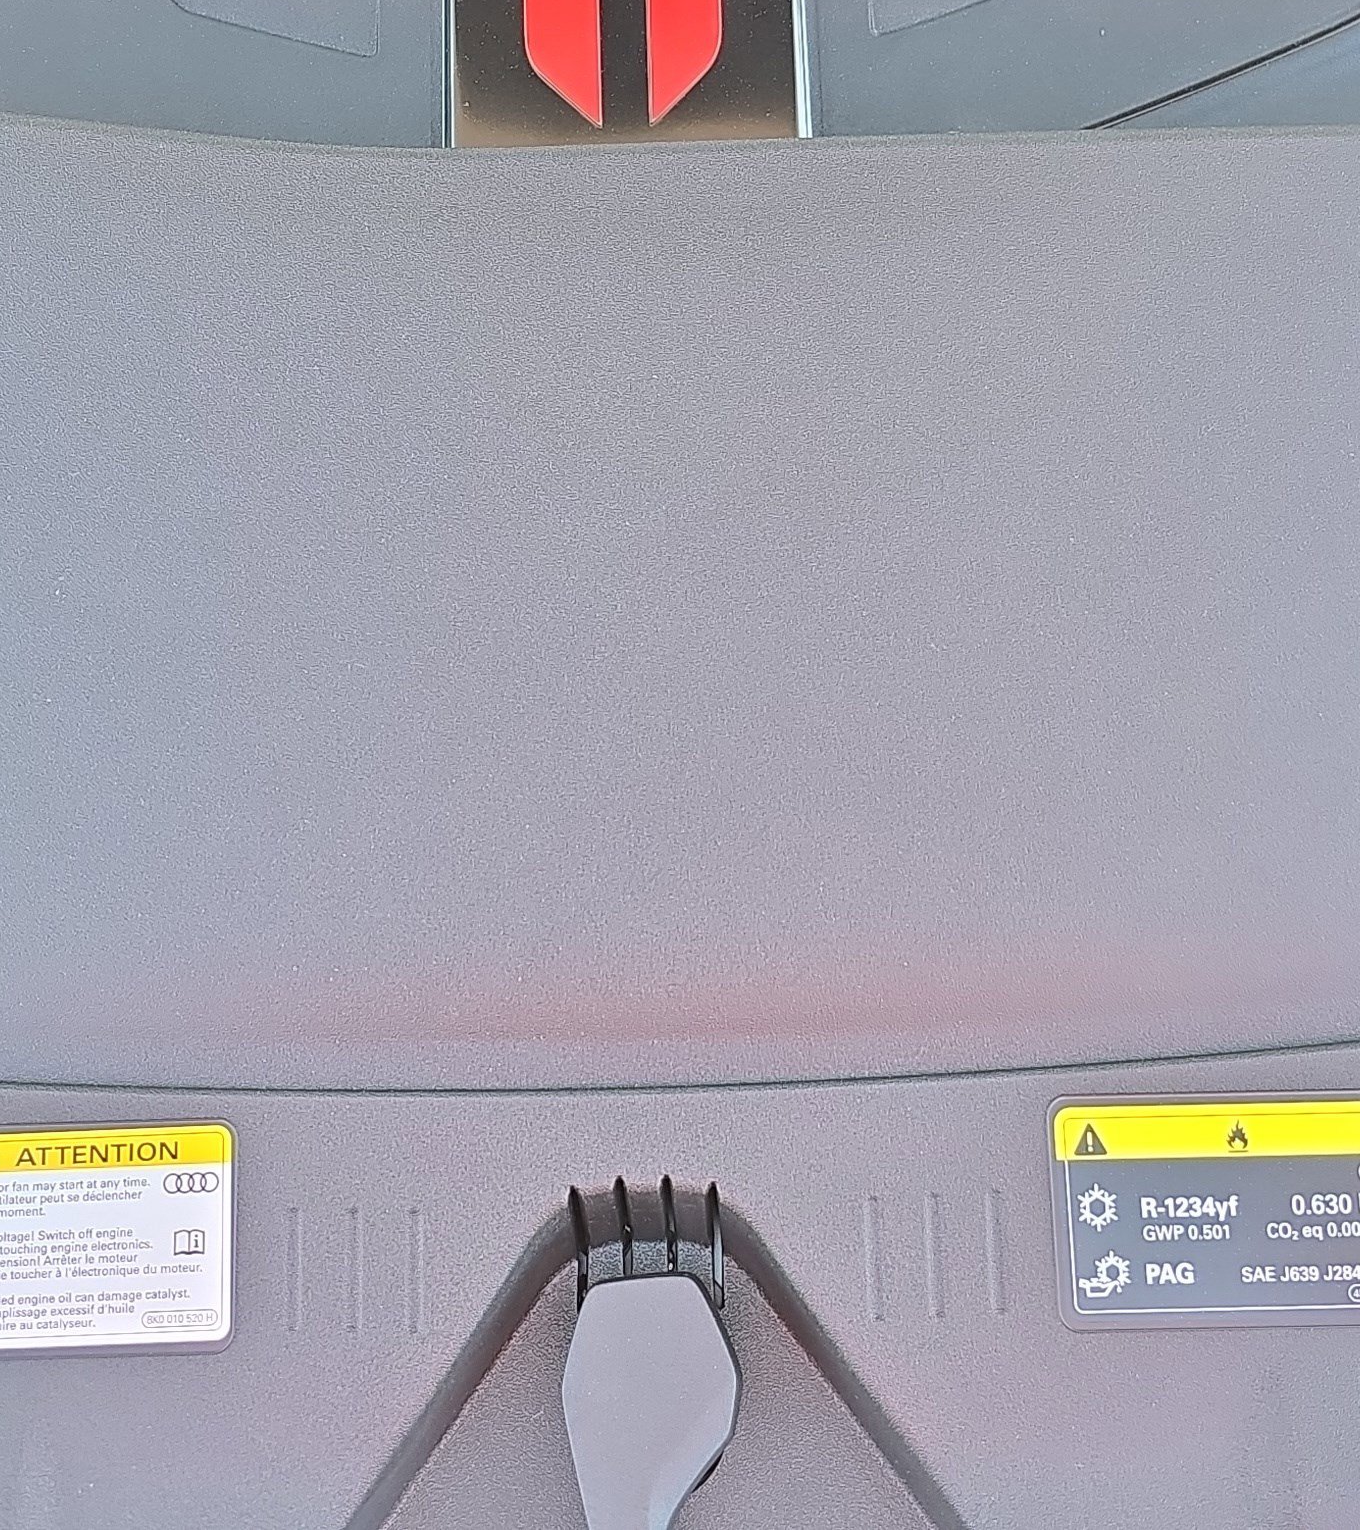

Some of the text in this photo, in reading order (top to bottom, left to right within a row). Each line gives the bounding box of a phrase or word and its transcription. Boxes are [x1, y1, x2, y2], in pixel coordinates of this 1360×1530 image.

[15, 1141, 178, 1167] ATTENTION
[11, 1181, 30, 1192] fan
[32, 1182, 57, 1193] may
[58, 1180, 84, 1191] start
[86, 1179, 98, 1189] at
[99, 1179, 121, 1190] any
[122, 1176, 151, 1188] time.
[39, 1193, 65, 1206] peut
[66, 1193, 80, 1203] se
[82, 1189, 143, 1202] déclencher
[1291, 1193, 1353, 1216] 0.630
[1140, 1195, 1239, 1222] R-1234yf
[37, 1228, 76, 1241] Switch
[78, 1227, 94, 1240] off
[95, 1226, 133, 1241] engine
[1142, 1224, 1231, 1242] GWP 0.501
[1301, 1225, 1324, 1241] eq
[50, 1241, 89, 1255] engine
[90, 1238, 154, 1252] electronics.
[42, 1254, 83, 1266] Arrêter
[85, 1253, 95, 1265] le
[97, 1253, 138, 1264] moteur
[10, 1268, 53, 1280] toucher
[65, 1264, 140, 1278] l'électronique
[142, 1263, 157, 1275] du
[160, 1264, 203, 1274] moteur.
[1145, 1262, 1195, 1285] PAG
[1241, 1266, 1278, 1283] SAE
[1280, 1265, 1320, 1282] J639
[17, 1293, 56, 1307] engine
[58, 1292, 72, 1304] oil
[74, 1293, 95, 1303] can
[97, 1290, 143, 1303] damage
[144, 1288, 191, 1301] catalyst.
[50, 1304, 95, 1317] excessif
[166, 1313, 185, 1324] 010
[206, 1312, 213, 1322] H
[19, 1321, 34, 1331] au
[36, 1318, 96, 1331] catalyseur.
